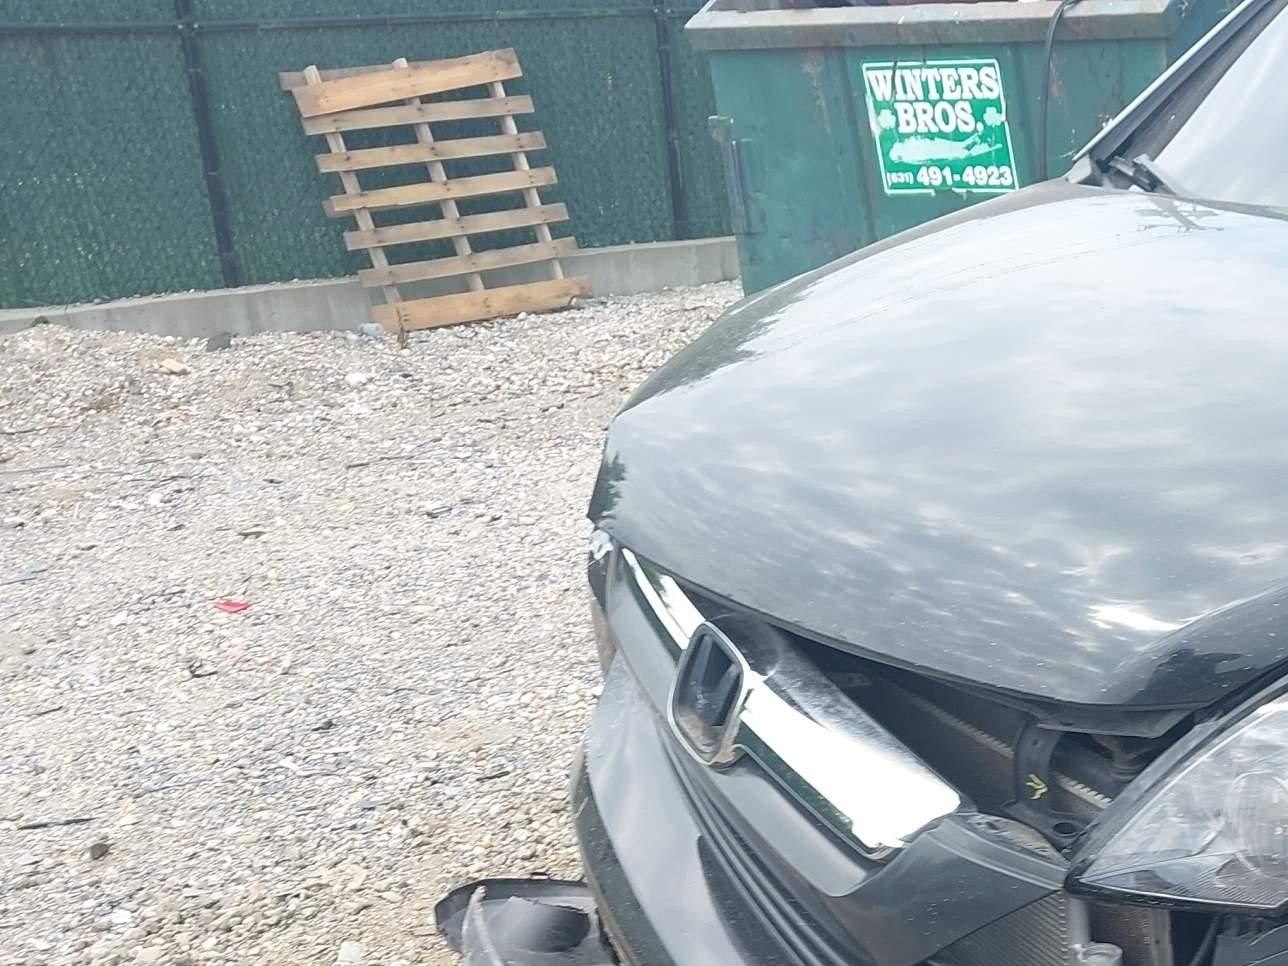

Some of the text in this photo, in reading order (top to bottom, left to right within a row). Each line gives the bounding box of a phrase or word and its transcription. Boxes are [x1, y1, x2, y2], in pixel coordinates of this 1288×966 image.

[866, 66, 1000, 101] WINTERS
[894, 101, 984, 134] BROS.
[917, 165, 1013, 186] 491-4923
